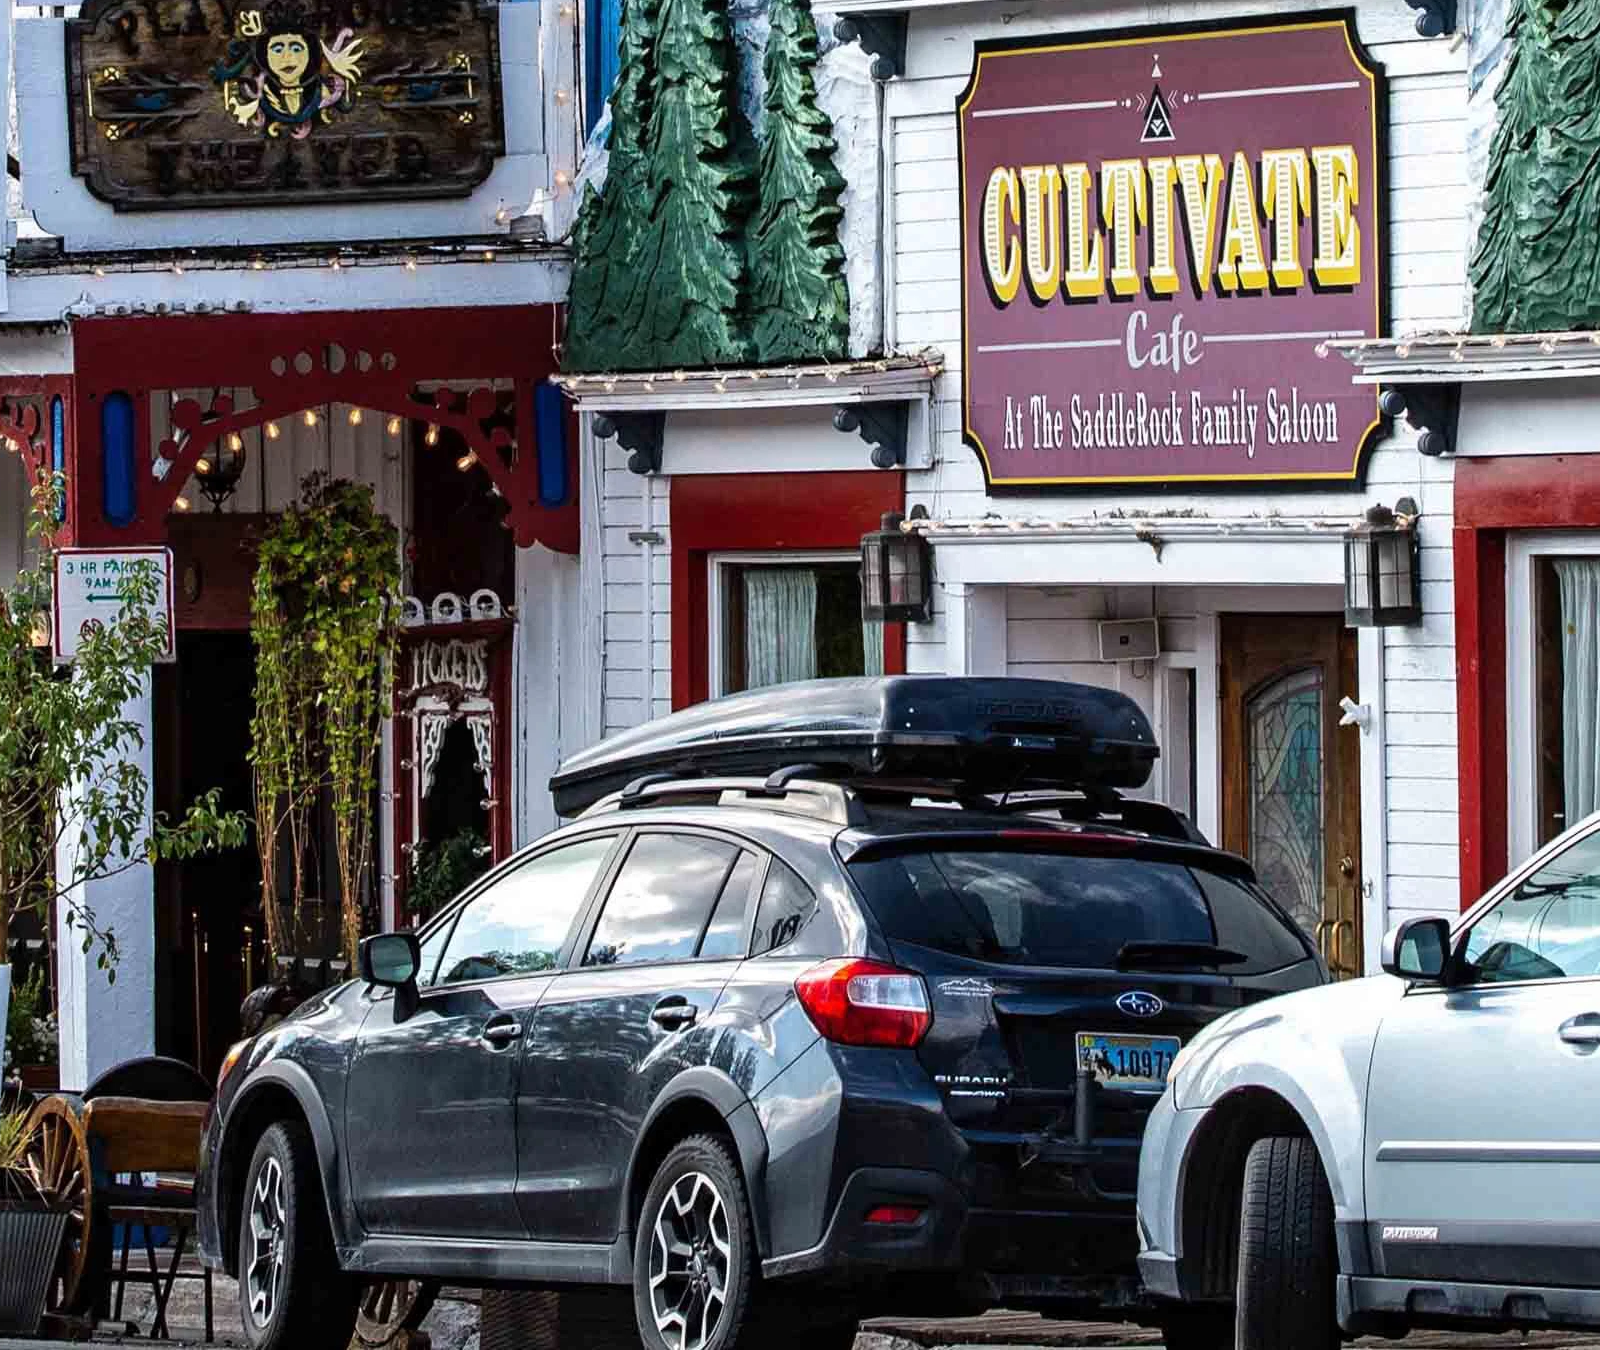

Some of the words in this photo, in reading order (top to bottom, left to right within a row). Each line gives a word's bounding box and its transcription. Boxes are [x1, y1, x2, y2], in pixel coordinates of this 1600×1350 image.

[979, 145, 1361, 307] CULTIVATE
[1126, 309, 1205, 374] Cafe
[1003, 395, 1024, 449] At
[1030, 393, 1063, 448] The
[1070, 389, 1184, 449] SaddleRock
[1191, 389, 1258, 458] Family
[1266, 387, 1338, 445] Saloon
[66, 562, 74, 574] 3
[80, 562, 97, 573] HR
[409, 637, 489, 691] TICKETS
[934, 1075, 1008, 1083] SUBARU
